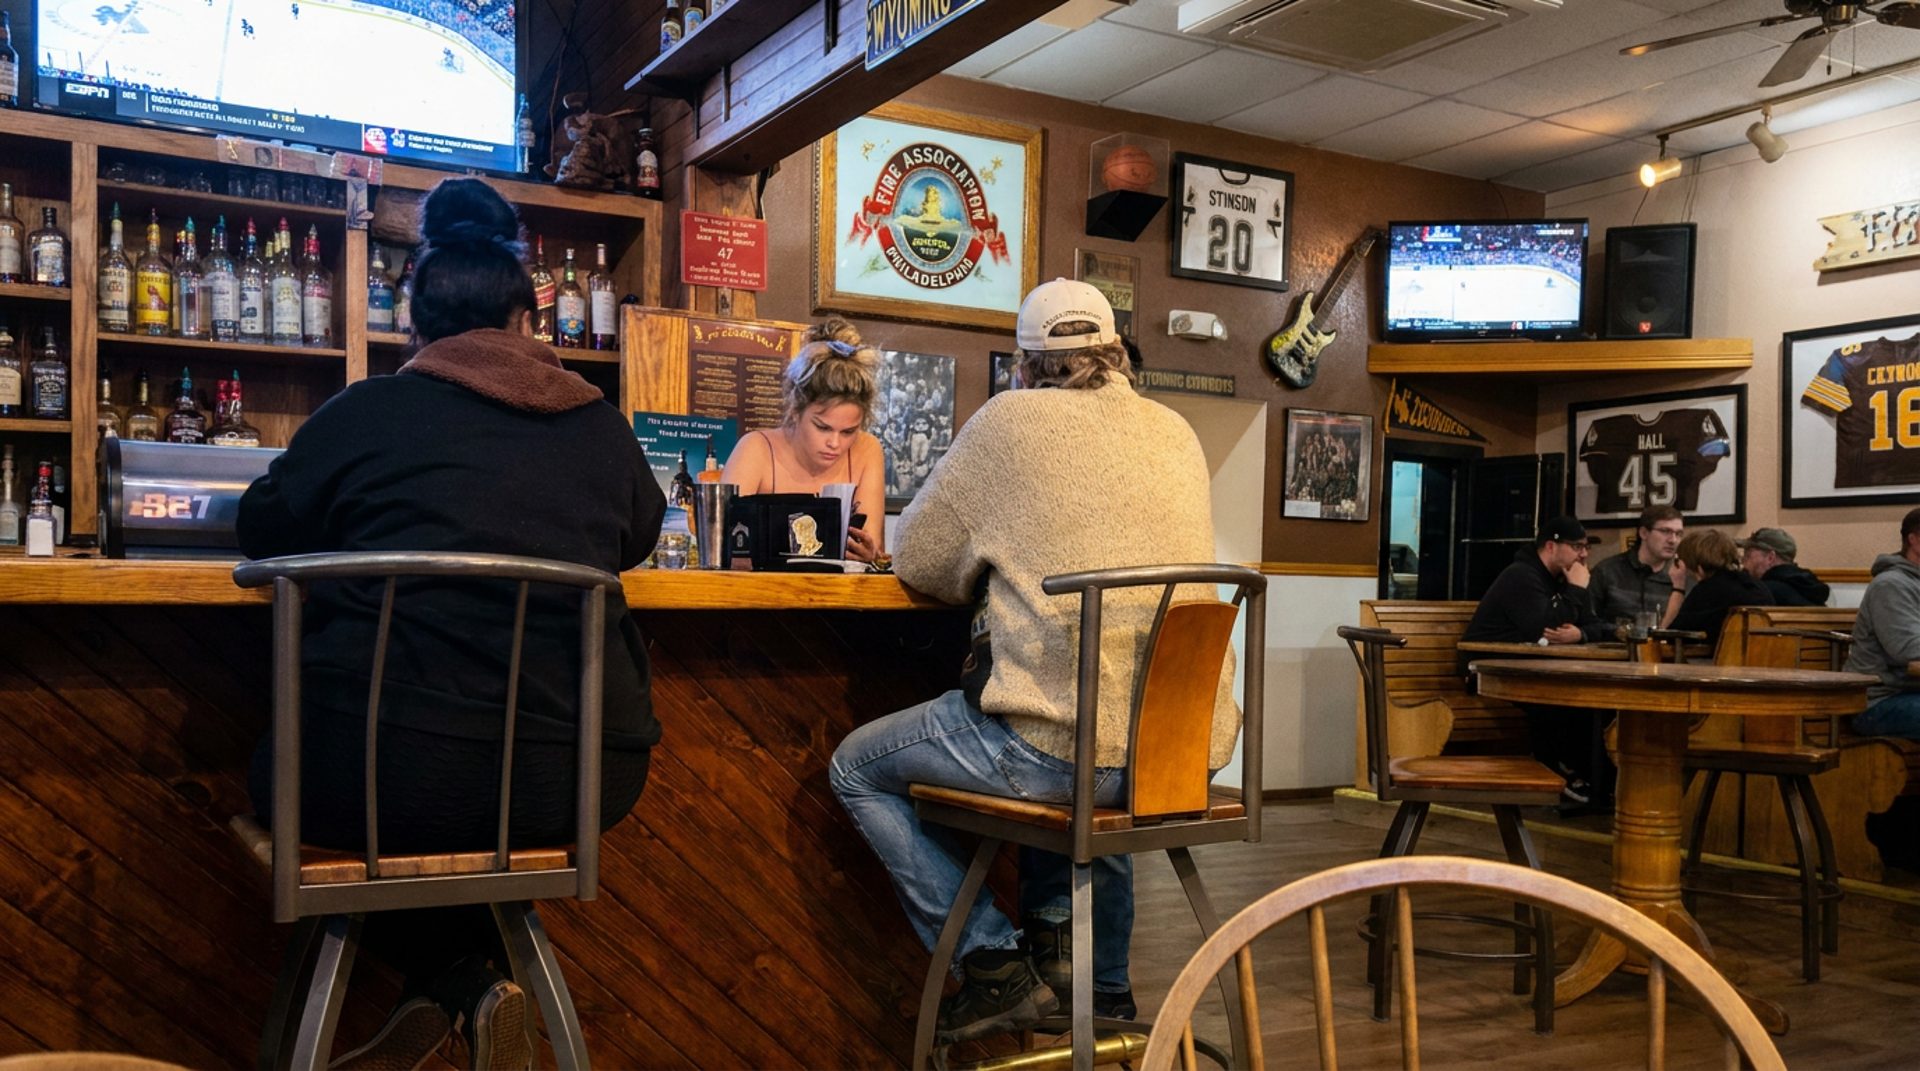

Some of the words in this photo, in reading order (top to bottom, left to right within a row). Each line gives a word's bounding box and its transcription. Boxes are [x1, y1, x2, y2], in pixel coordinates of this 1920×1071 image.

[1209, 189, 1257, 214] STINSON
[717, 247, 734, 260] 47
[1207, 214, 1254, 275] 20
[1638, 432, 1665, 450] HALL
[1618, 452, 1678, 510] 45
